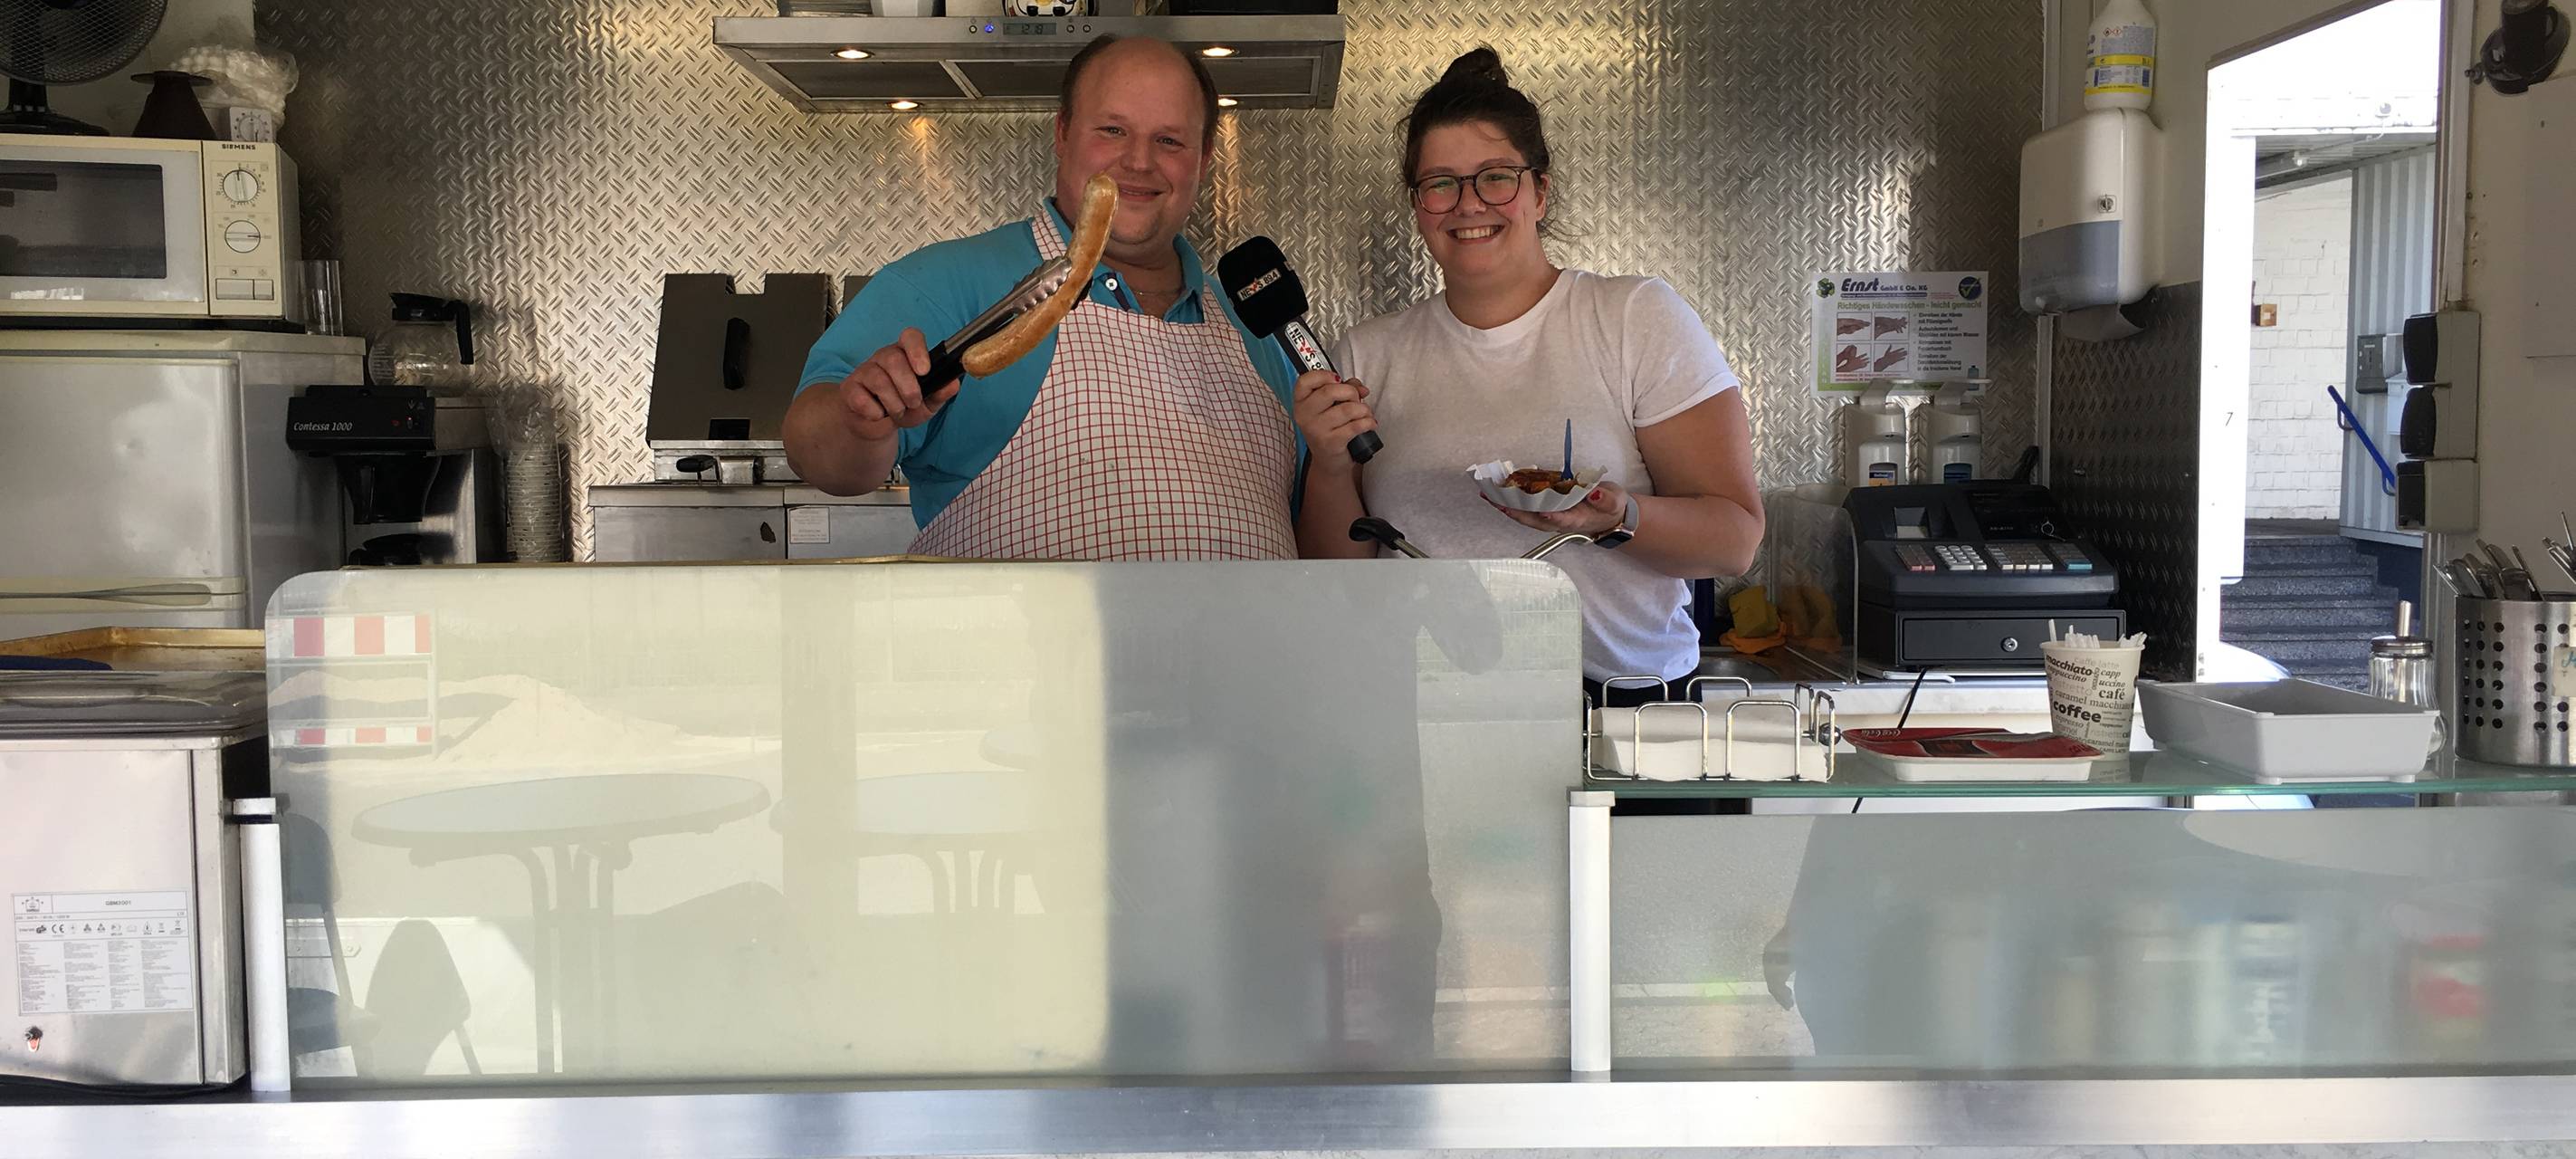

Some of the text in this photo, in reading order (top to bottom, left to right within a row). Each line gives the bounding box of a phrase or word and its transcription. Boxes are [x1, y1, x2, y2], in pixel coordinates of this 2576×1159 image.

[1841, 277, 1879, 292] Ernst
[293, 422, 353, 431] Contessa 1000
[2046, 654, 2093, 675] macchiato
[2101, 669, 2121, 678] capp
[2055, 689, 2087, 704] caramel
[2099, 687, 2125, 700] café
[2053, 700, 2102, 723] coffee
